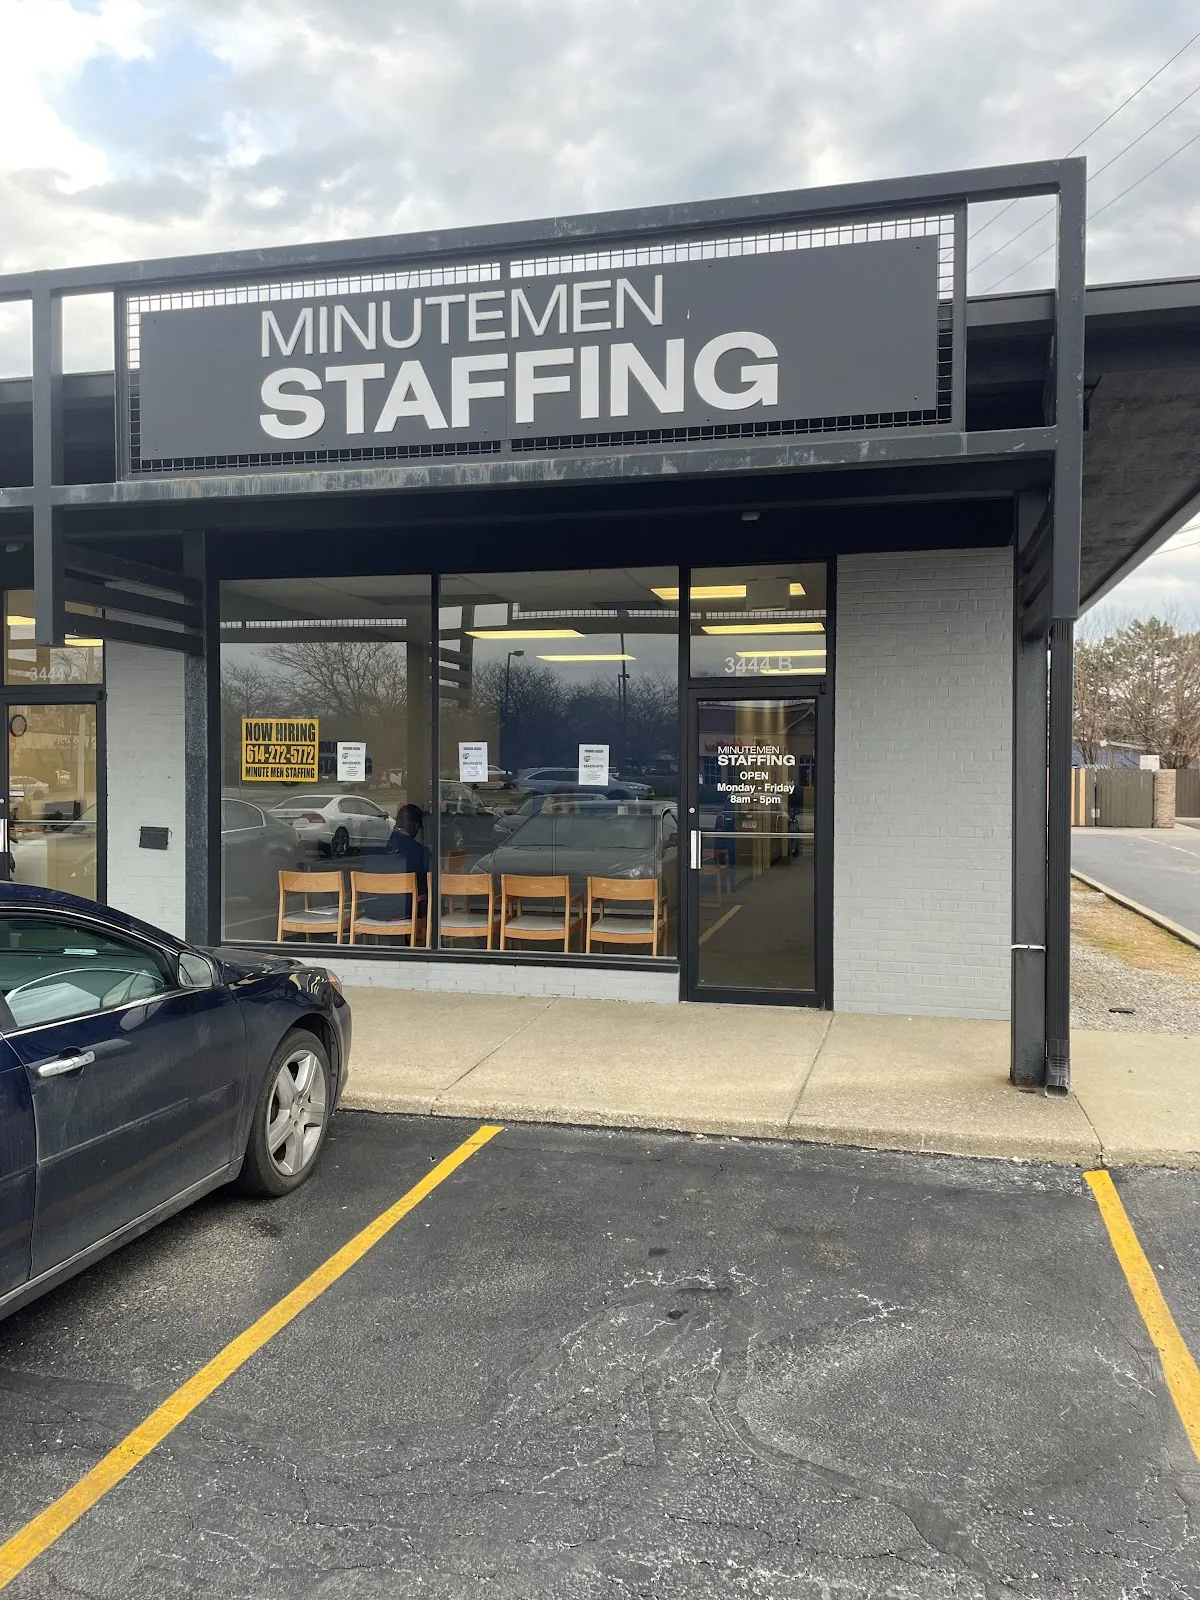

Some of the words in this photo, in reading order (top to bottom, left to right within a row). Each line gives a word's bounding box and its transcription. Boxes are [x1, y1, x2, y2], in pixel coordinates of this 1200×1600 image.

[260, 274, 664, 358] MINUTEMEN
[259, 331, 780, 440] STAFFING
[724, 656, 771, 673] 3444
[778, 655, 793, 672] B
[29, 666, 65, 681] 3444
[245, 722, 273, 742] NOW
[275, 722, 316, 742] HIRING
[246, 744, 315, 764] 614-272-5772
[717, 746, 780, 754] MINUTEMEN
[717, 754, 796, 766] STAFFING
[245, 767, 270, 779] MINUTE
[270, 767, 284, 779] MEN
[285, 766, 315, 779] STAFFING
[739, 771, 769, 781] OPEN
[717, 783, 756, 794] Monday
[764, 783, 795, 794] Friday
[730, 796, 751, 804] 8am
[759, 796, 781, 805] 5pm
